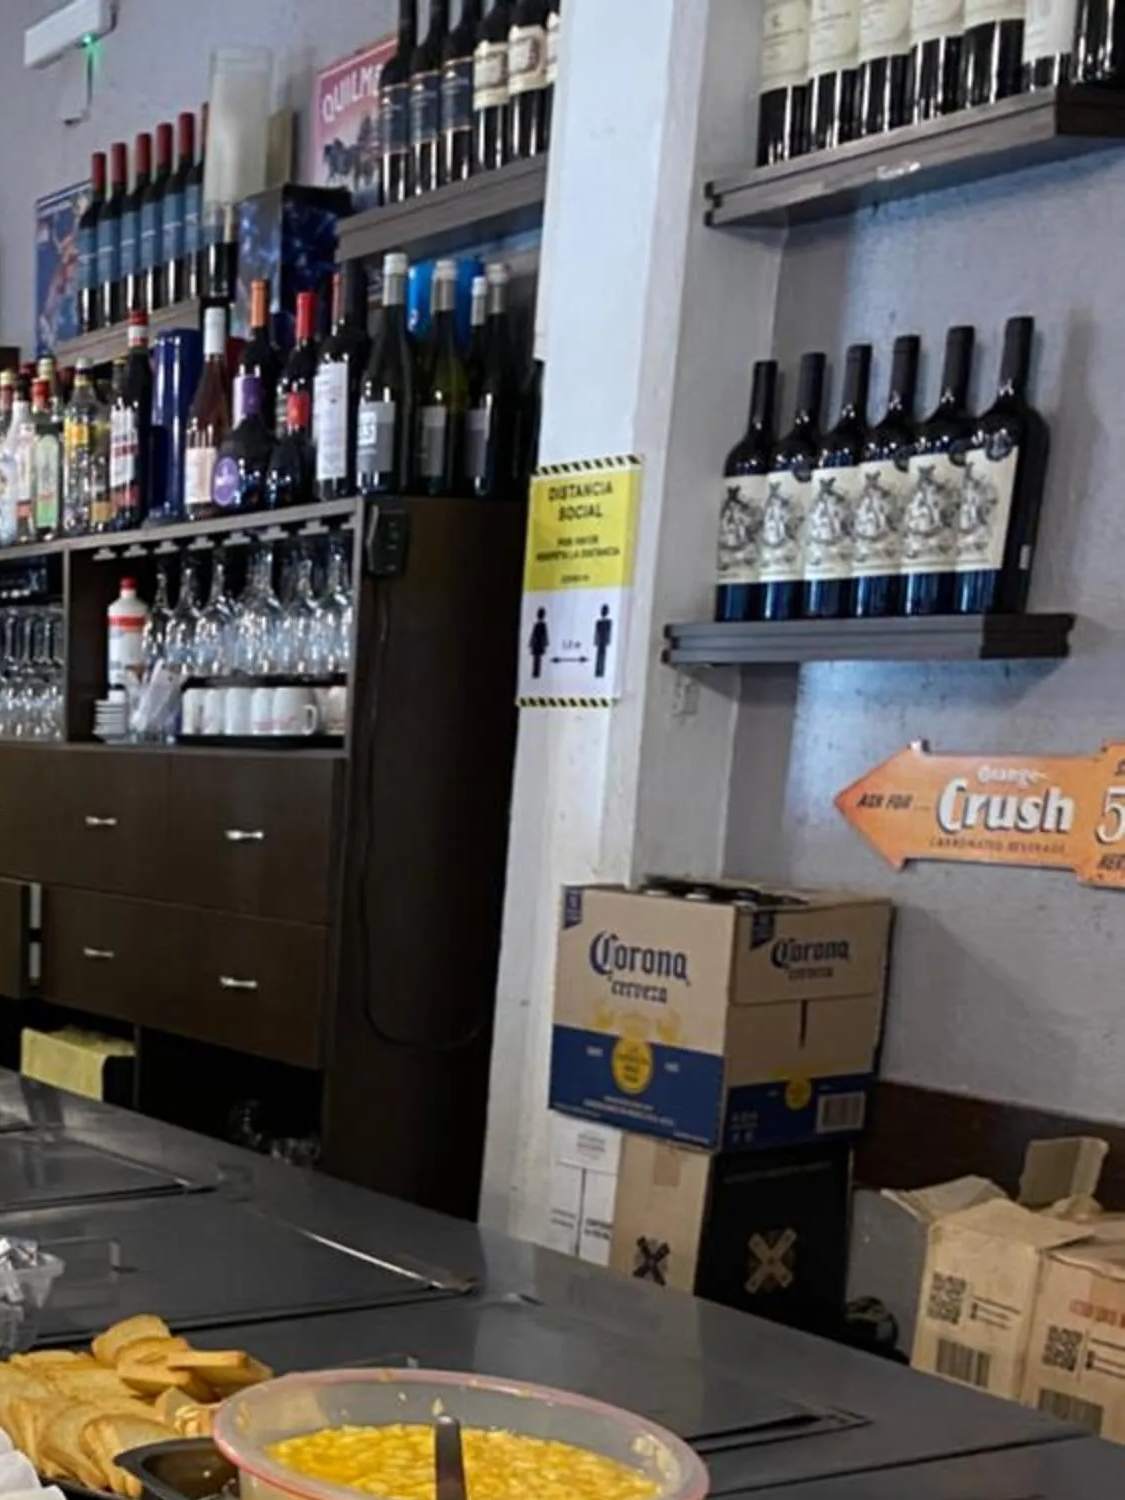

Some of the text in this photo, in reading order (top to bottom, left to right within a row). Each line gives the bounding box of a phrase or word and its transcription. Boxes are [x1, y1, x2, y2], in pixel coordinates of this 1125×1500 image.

[322, 63, 383, 122] QUILME
[548, 481, 613, 502] DISTANCIA
[558, 503, 603, 521] SOCIAL
[856, 792, 884, 809] ASK
[936, 777, 1074, 834] Crush
[589, 930, 690, 984] Corona
[771, 938, 851, 969] Corona
[609, 978, 667, 1003] cerveza
